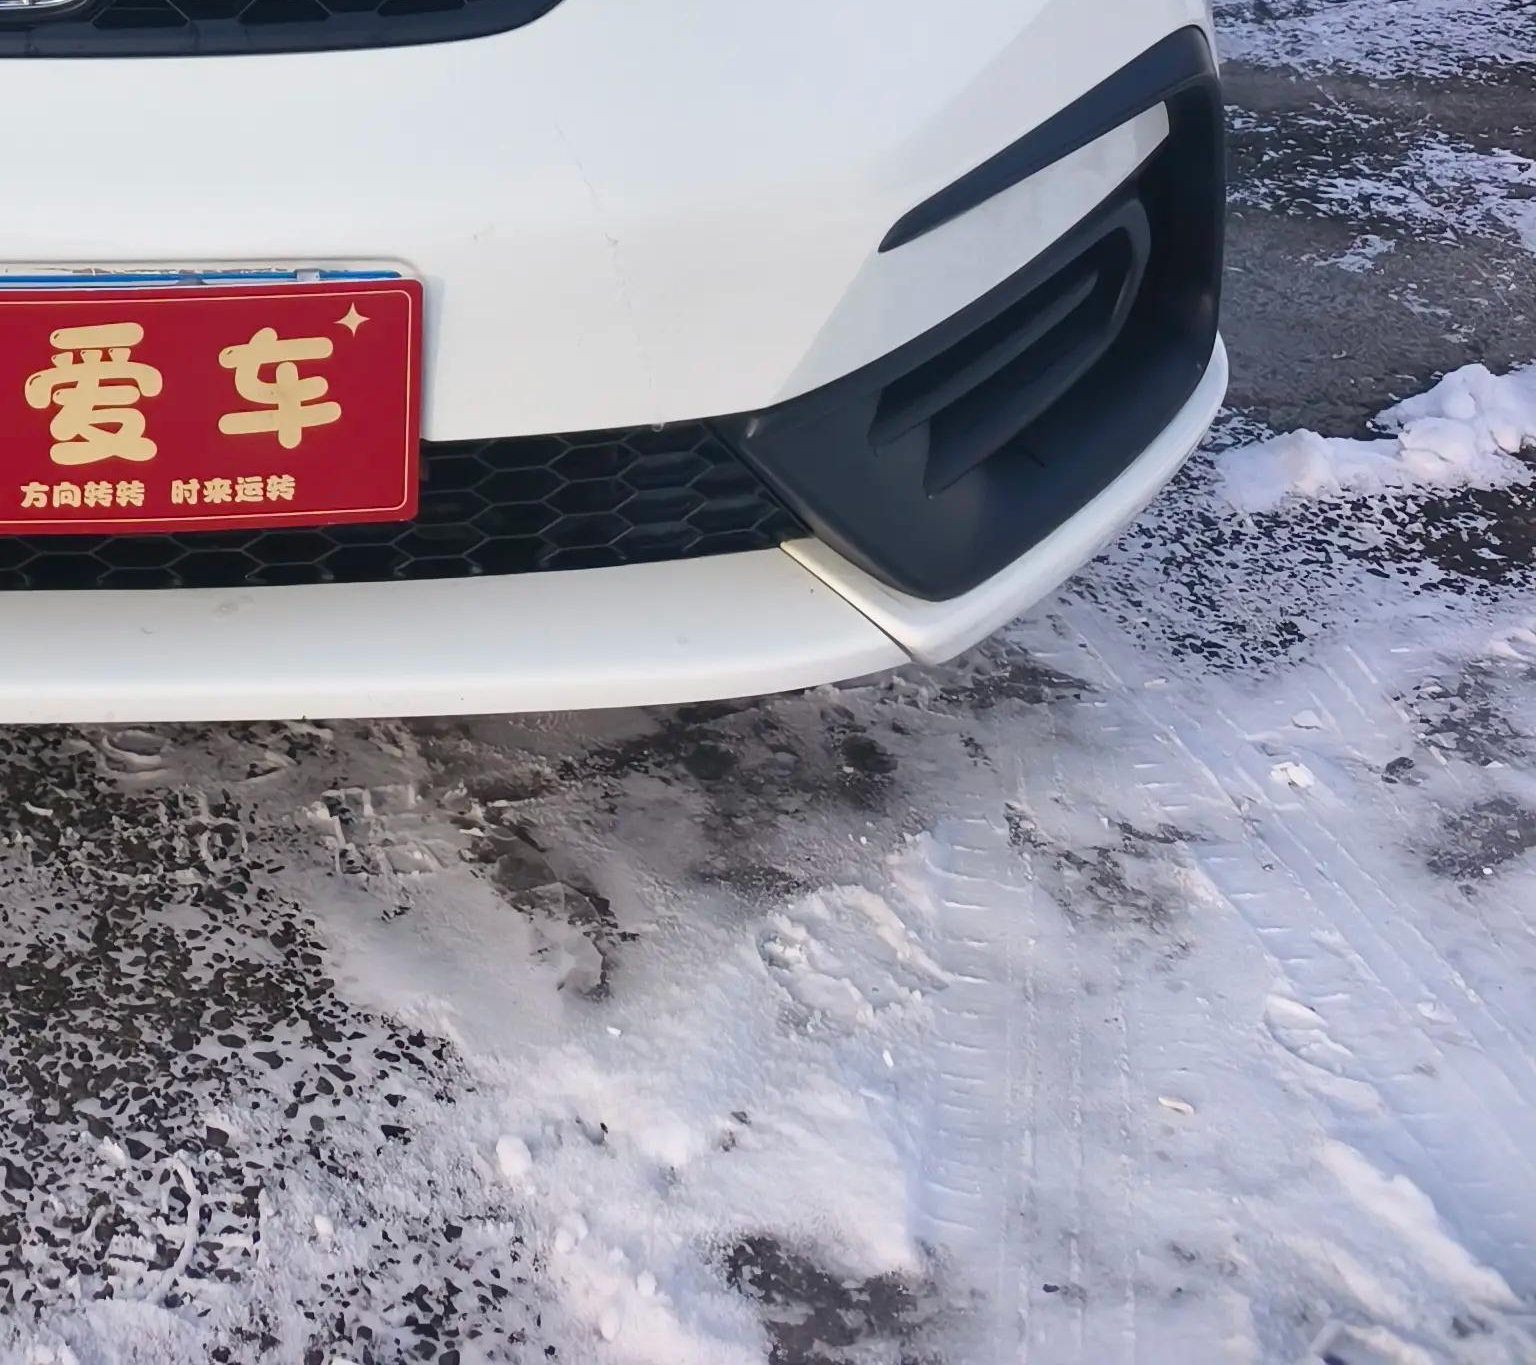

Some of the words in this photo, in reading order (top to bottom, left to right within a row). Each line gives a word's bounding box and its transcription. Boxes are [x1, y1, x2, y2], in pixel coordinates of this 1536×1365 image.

[20, 480, 145, 508] 方向转转
[171, 474, 296, 504] 时来运转
